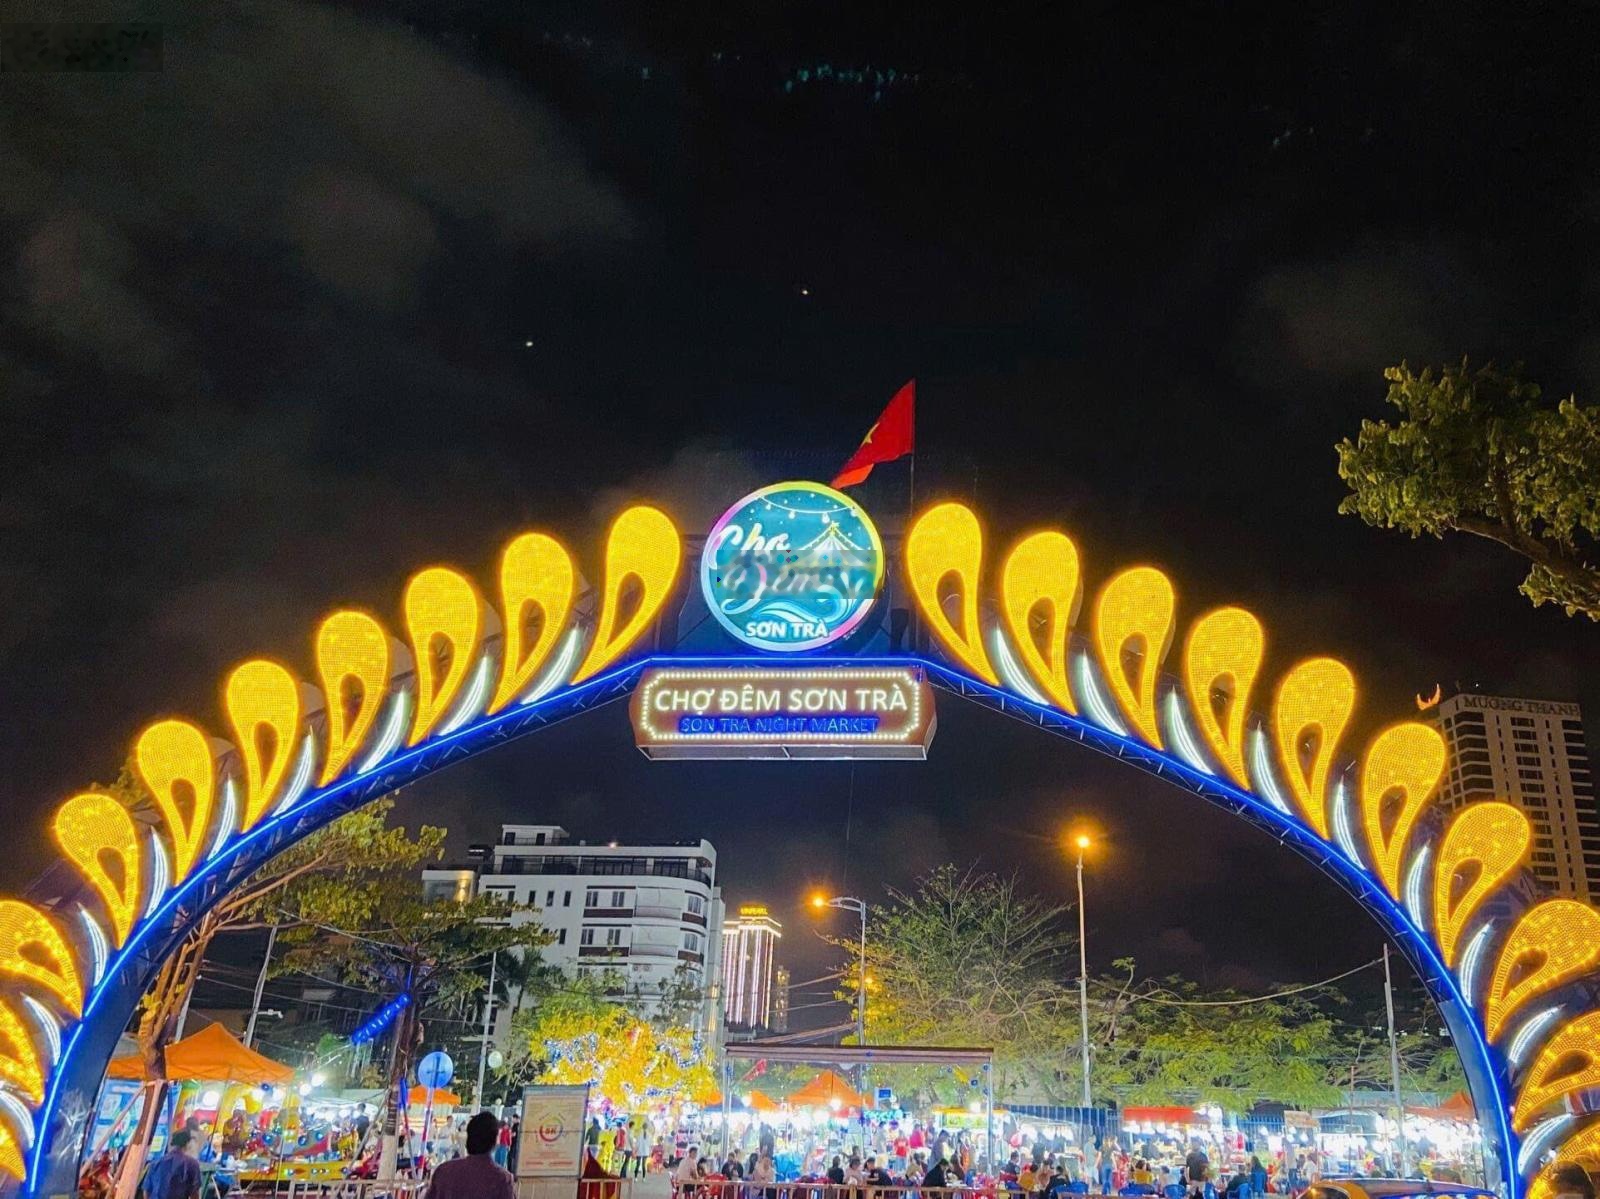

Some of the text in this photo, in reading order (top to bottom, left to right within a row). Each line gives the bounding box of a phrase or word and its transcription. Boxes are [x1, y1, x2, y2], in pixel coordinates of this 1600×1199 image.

[746, 618, 829, 638] SƠN TRÀ
[655, 682, 908, 716] CHỢ ĐÊM SƠN TRÀ
[681, 717, 880, 732] SON TRA NIGHT MARKET
